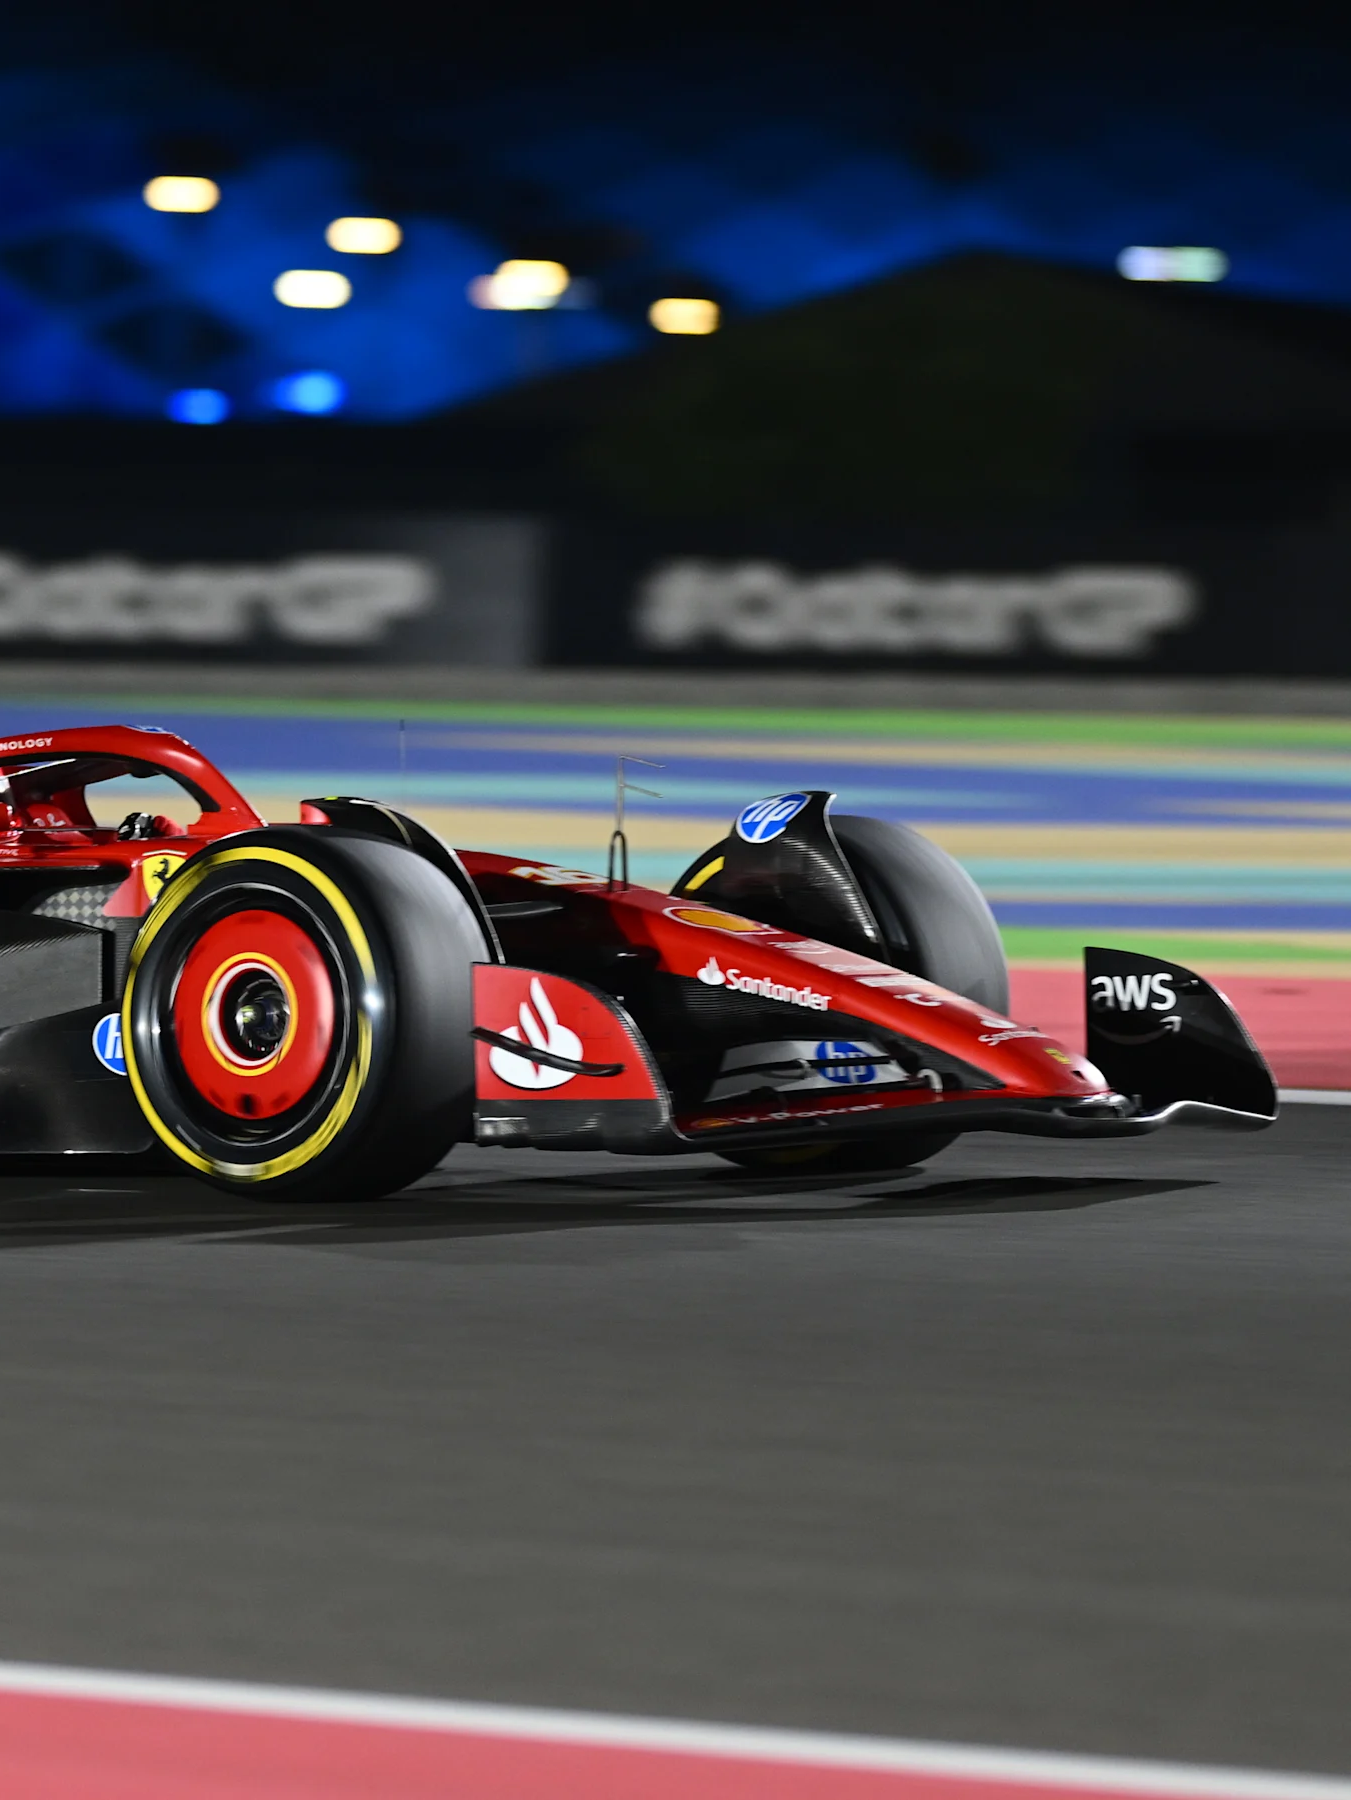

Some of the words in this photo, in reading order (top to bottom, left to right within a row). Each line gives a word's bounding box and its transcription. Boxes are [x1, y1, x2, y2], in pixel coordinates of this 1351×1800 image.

[741, 793, 803, 841] hp
[726, 968, 832, 1011] Santander
[1091, 972, 1177, 1011] aws
